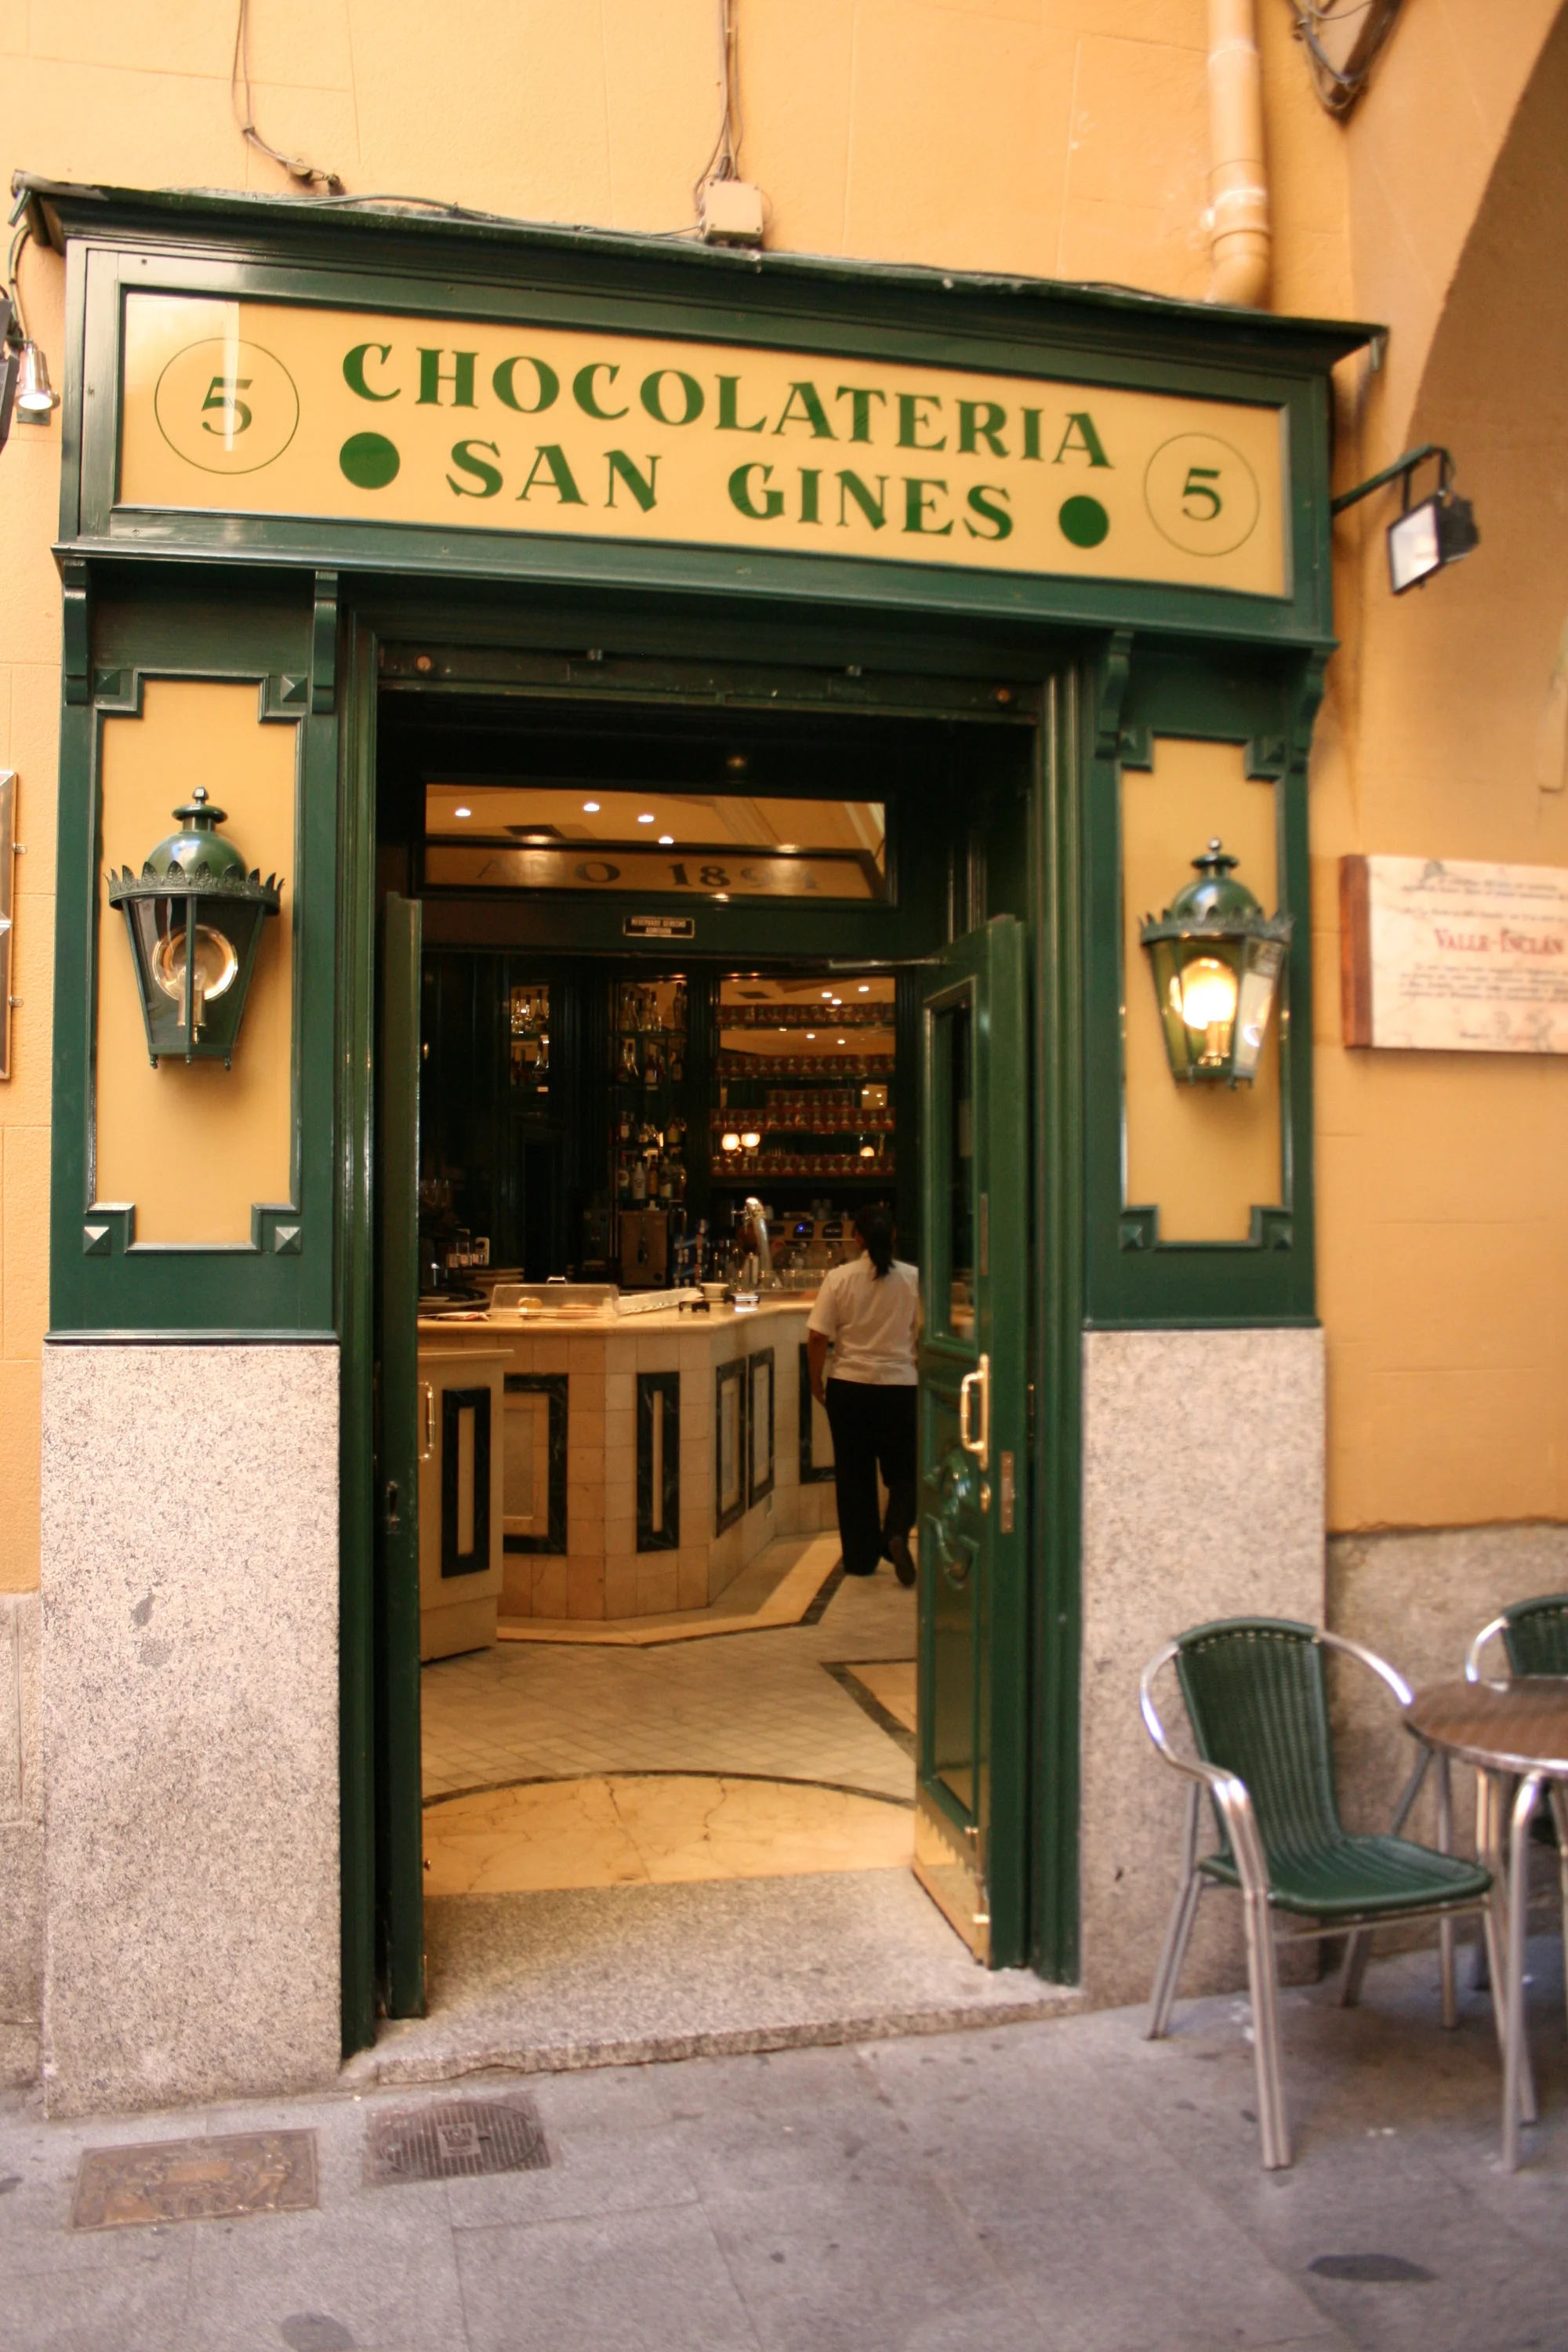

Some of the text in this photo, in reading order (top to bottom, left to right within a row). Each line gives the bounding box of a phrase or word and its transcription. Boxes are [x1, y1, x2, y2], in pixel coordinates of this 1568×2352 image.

[201, 376, 253, 436] 5
[342, 342, 1116, 469] CHOCOLATERIA
[445, 439, 1014, 542] SAN GINES
[1181, 467, 1224, 521] 5
